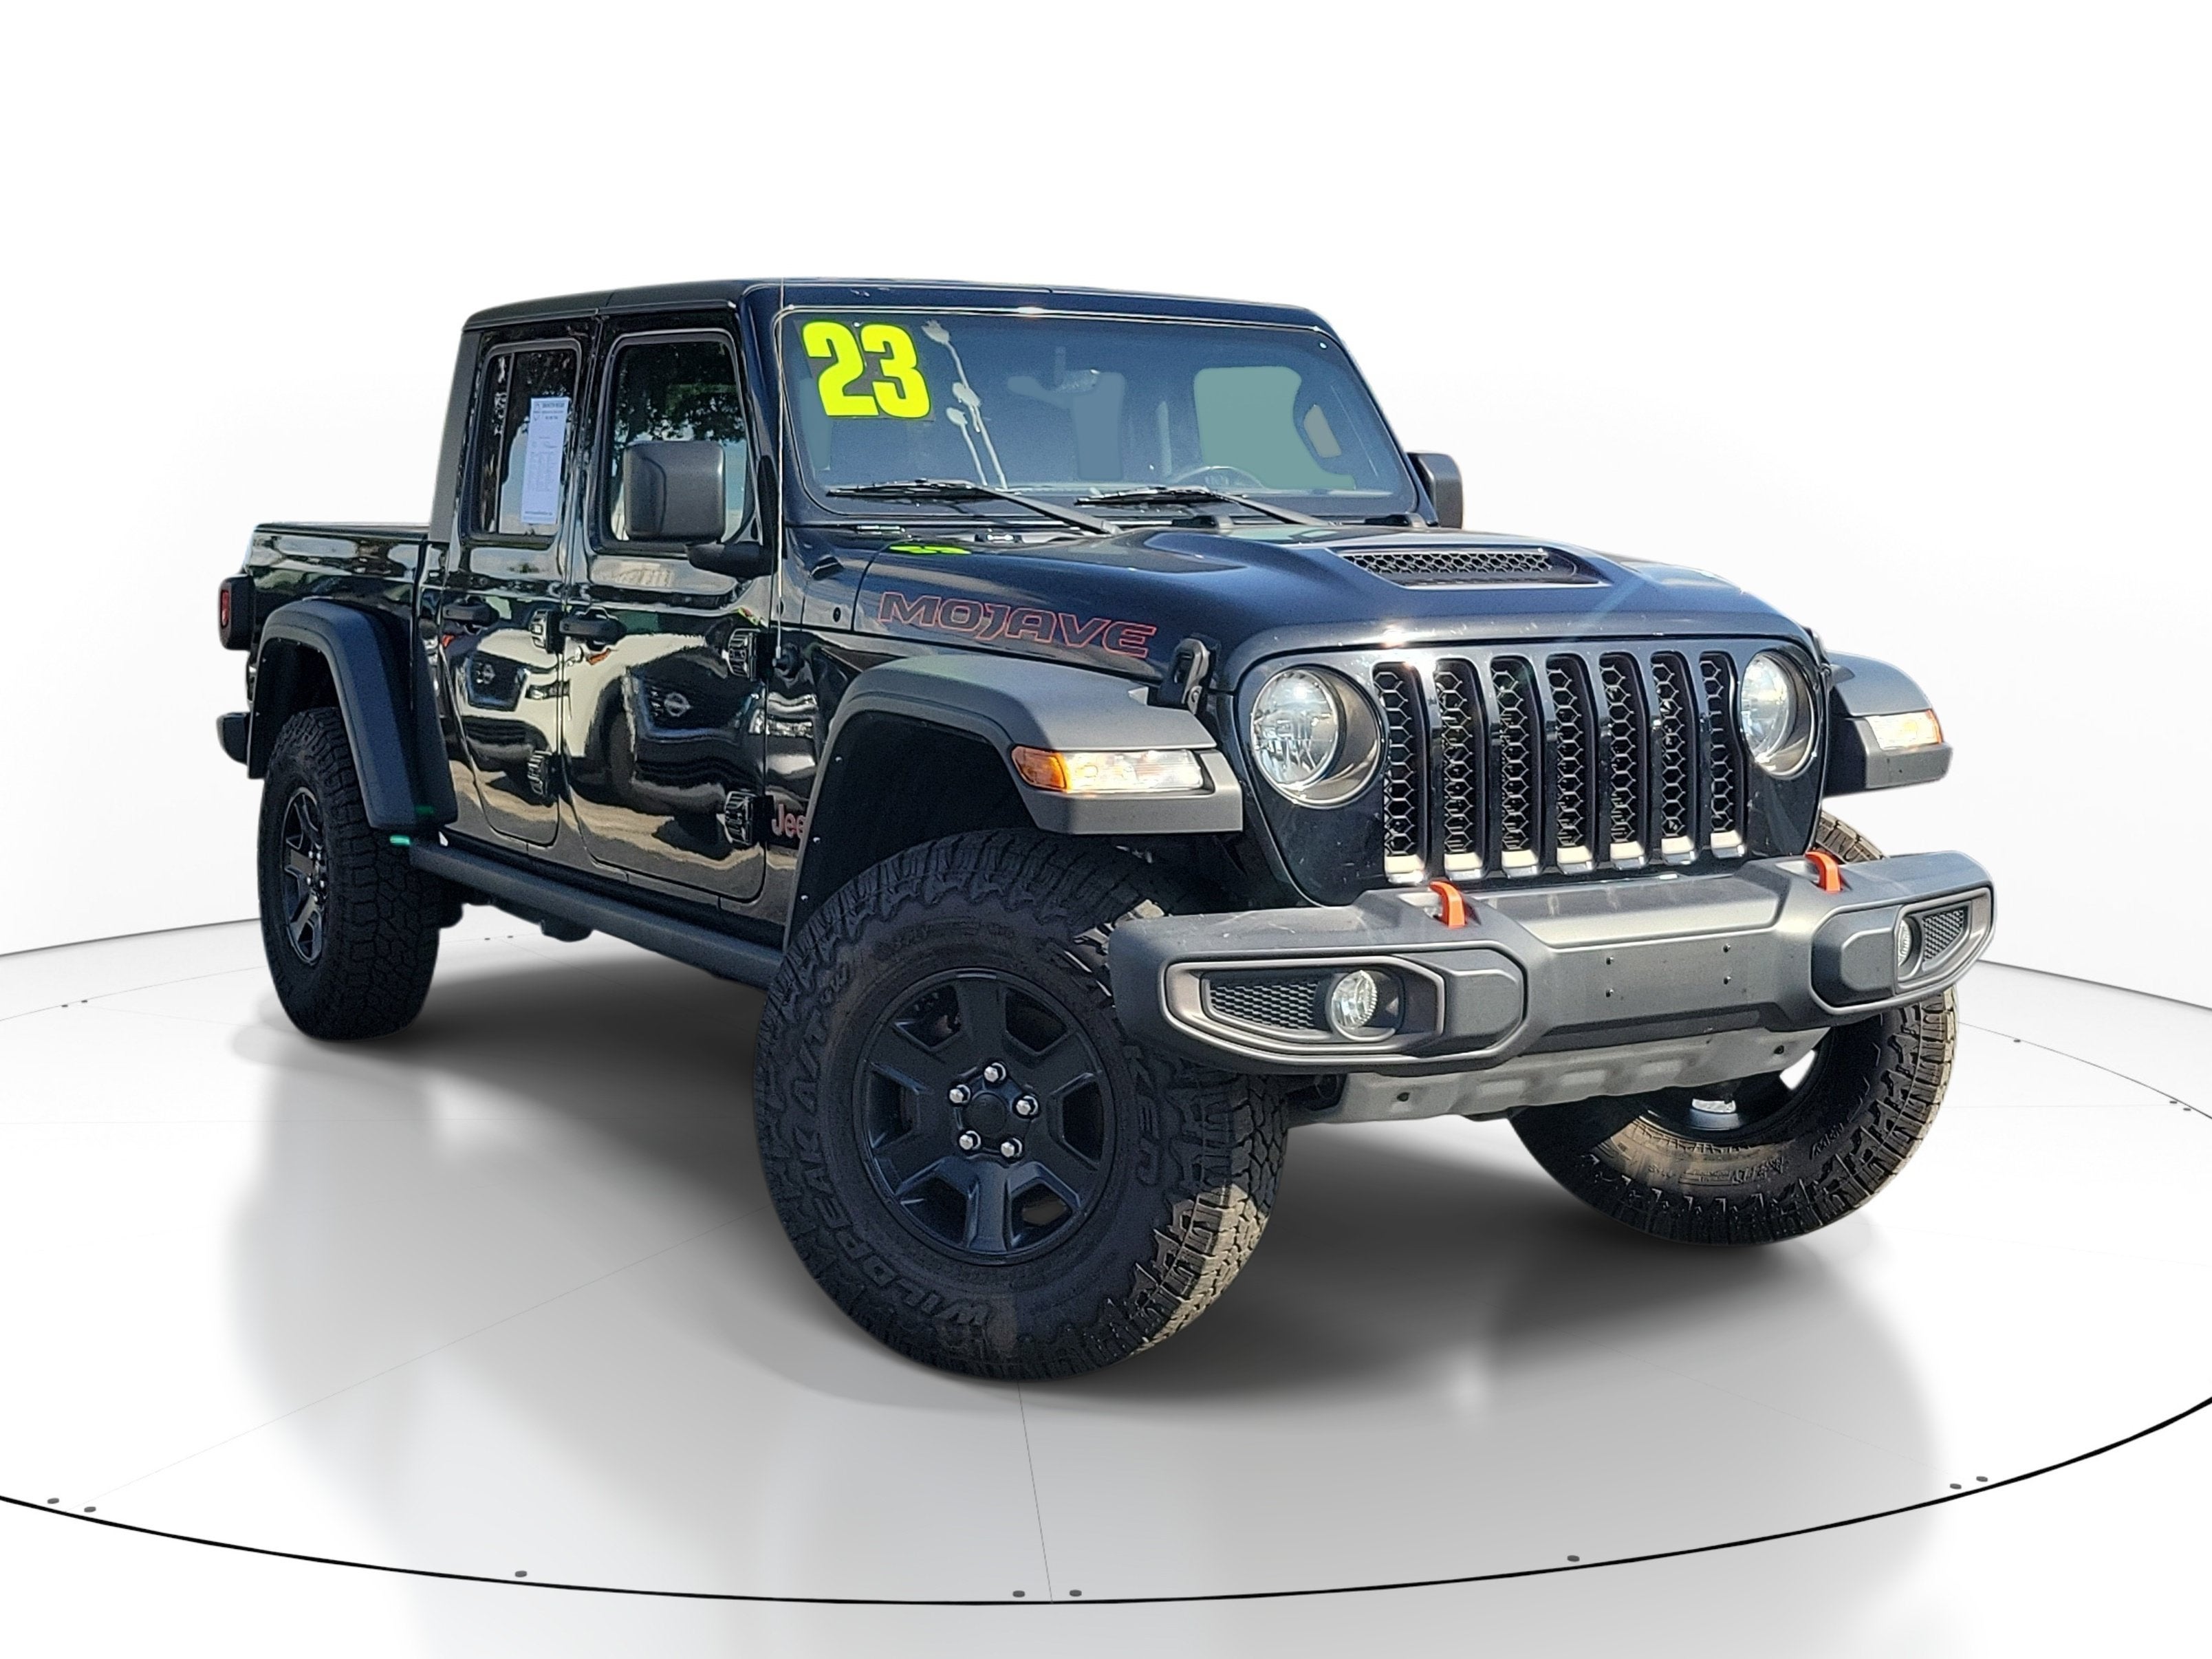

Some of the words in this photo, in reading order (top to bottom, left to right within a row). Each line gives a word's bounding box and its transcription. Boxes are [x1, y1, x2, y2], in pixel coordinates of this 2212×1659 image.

[801, 321, 931, 419] 23
[878, 591, 1158, 660] MOJAVE
[771, 803, 807, 840] Jee
[794, 1127, 989, 1327] WILDPEAK
